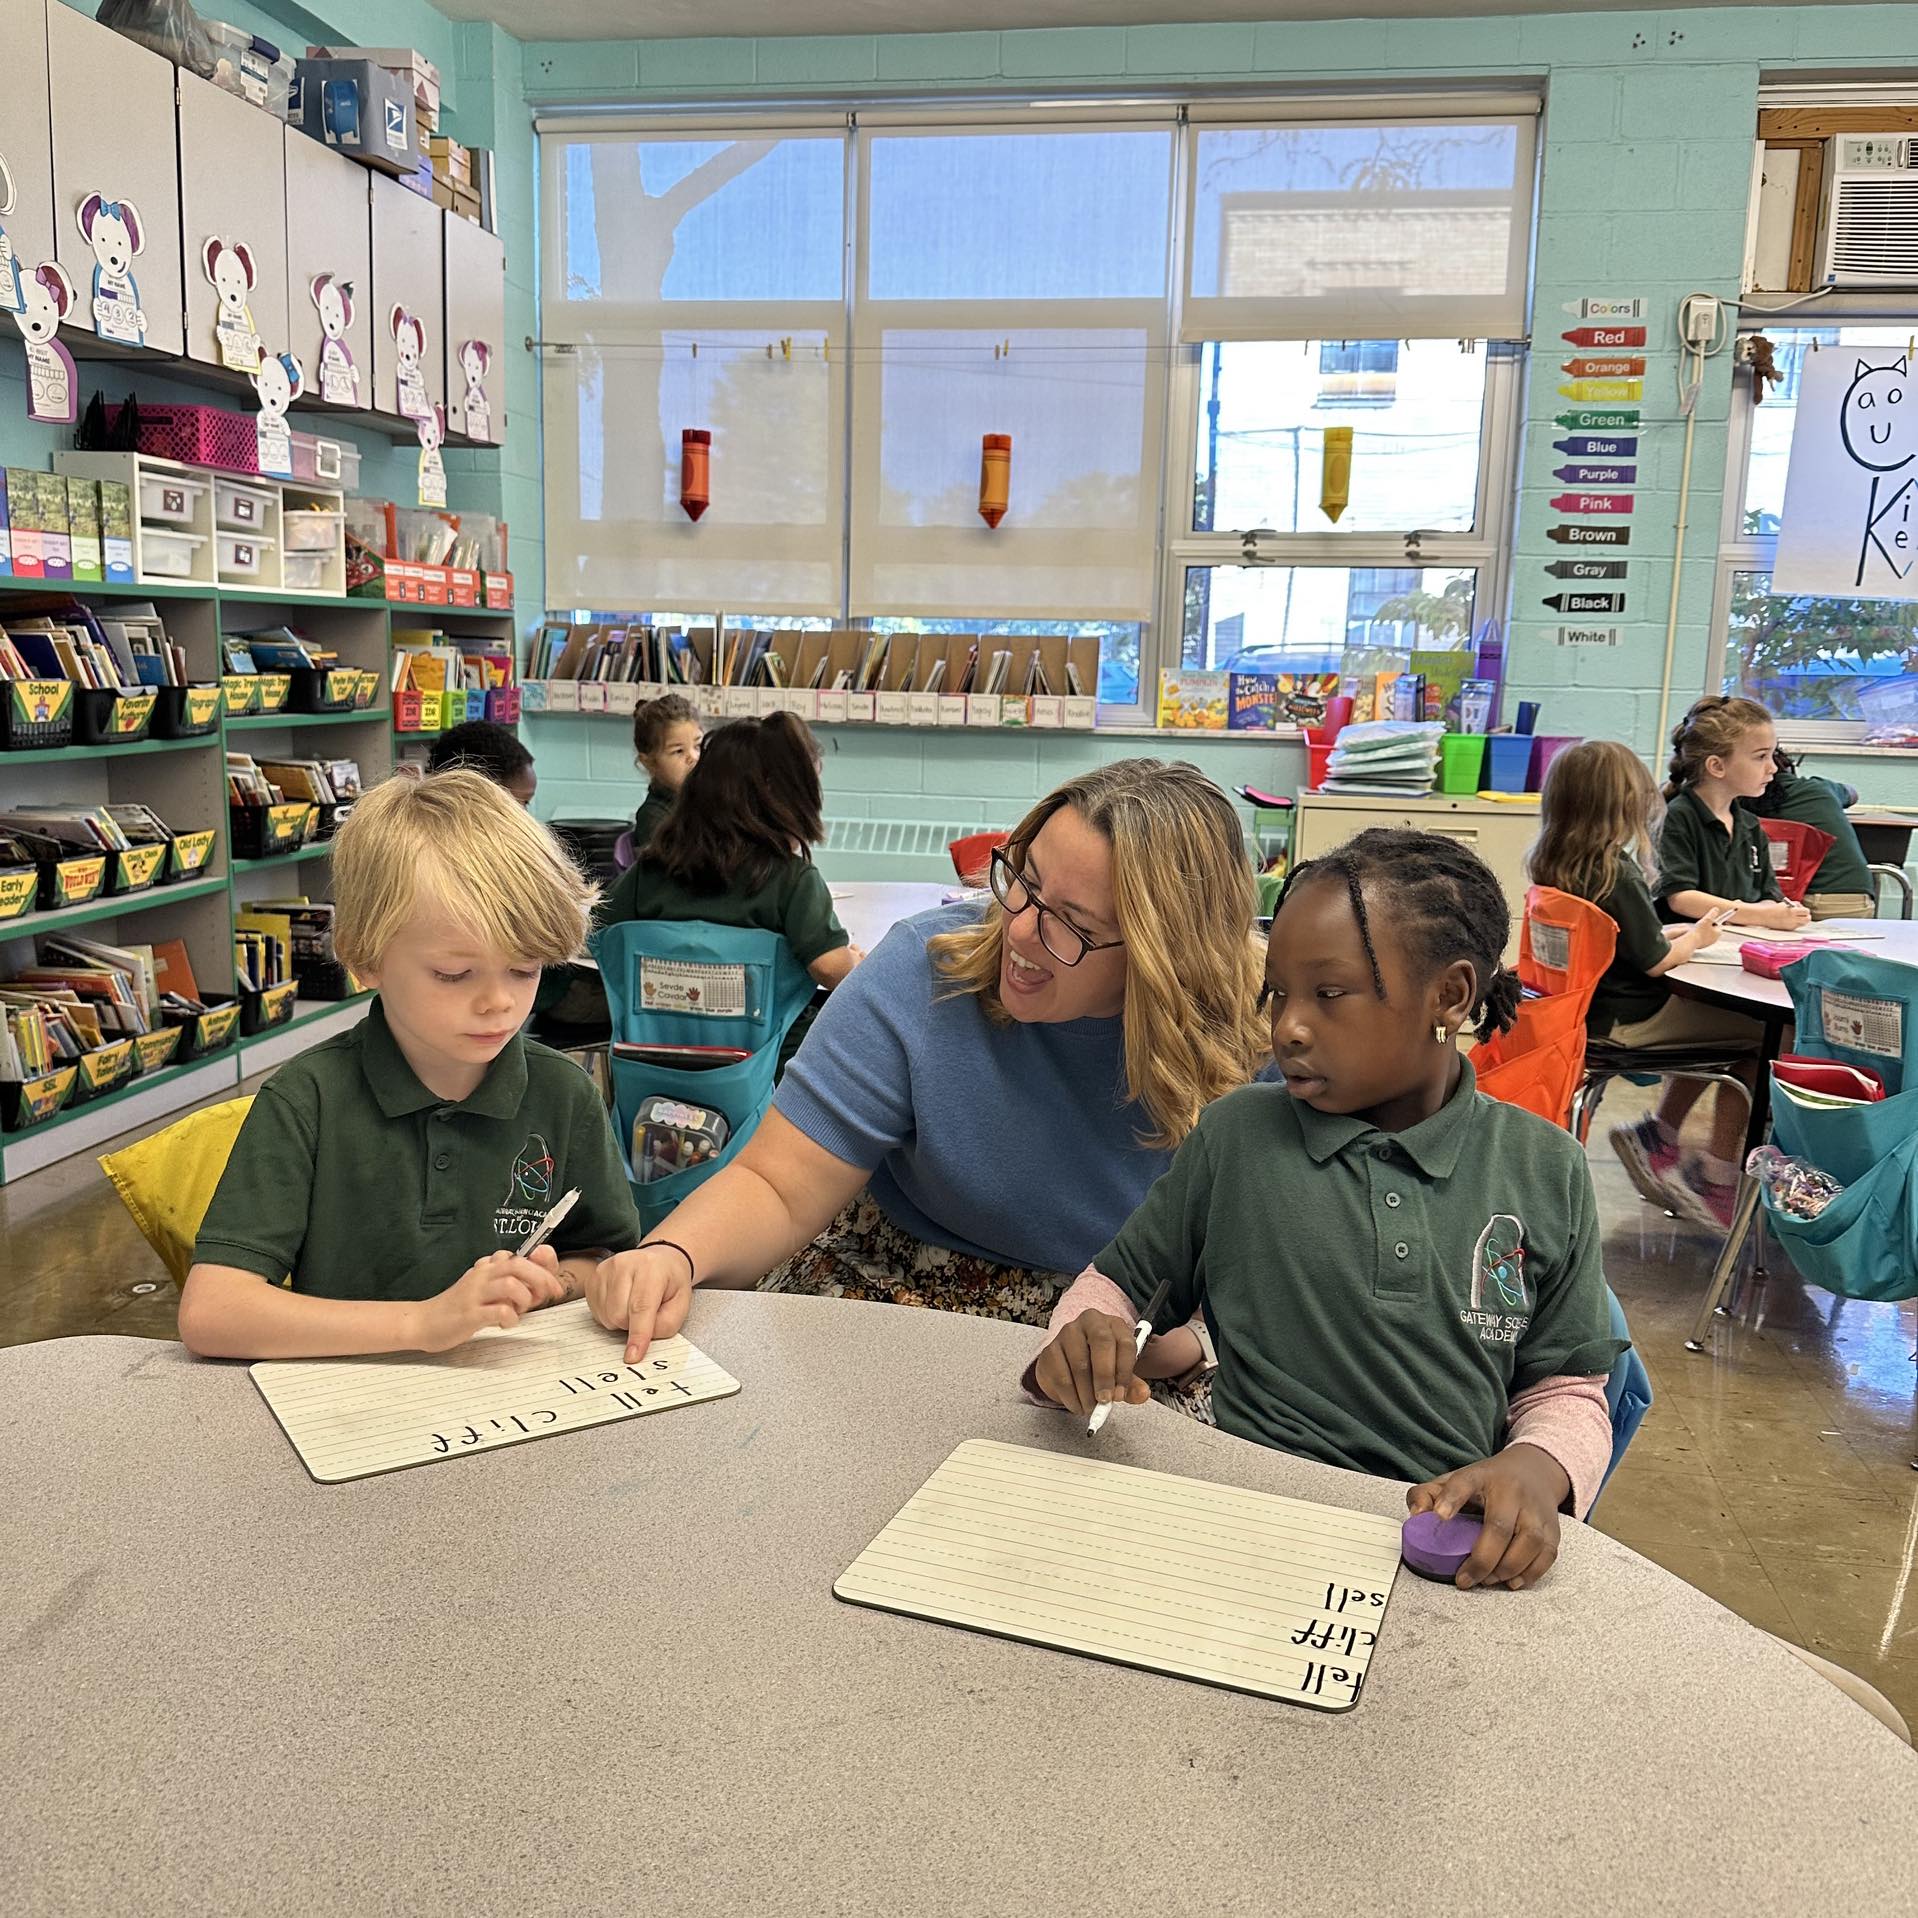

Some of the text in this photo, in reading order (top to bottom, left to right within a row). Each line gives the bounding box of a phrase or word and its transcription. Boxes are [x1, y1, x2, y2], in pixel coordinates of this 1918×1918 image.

[1590, 303, 1631, 314] Colors
[1593, 331, 1625, 344] Red
[1585, 361, 1631, 374] Orange
[1586, 386, 1629, 398] Yellow
[1579, 413, 1625, 426] Green
[1586, 441, 1617, 453] Blue
[1579, 468, 1619, 481] Purple
[1579, 497, 1612, 510] Pink
[1568, 528, 1617, 542] Brown
[1573, 564, 1608, 578] Gray
[1570, 598, 1610, 609] Black
[1567, 631, 1606, 643] White
[28, 683, 60, 696] School
[1235, 692, 1277, 712] MONSTE
[180, 836, 209, 851] Old Lady
[1, 879, 24, 893] Early
[1459, 1310, 1502, 1328] GATEWAY
[1479, 1327, 1518, 1342] ACADEM
[431, 1381, 692, 1453] tell cliff
[1324, 1582, 1385, 1613] sell
[1290, 1619, 1377, 1656] cliff
[1301, 1661, 1363, 1703] tell
